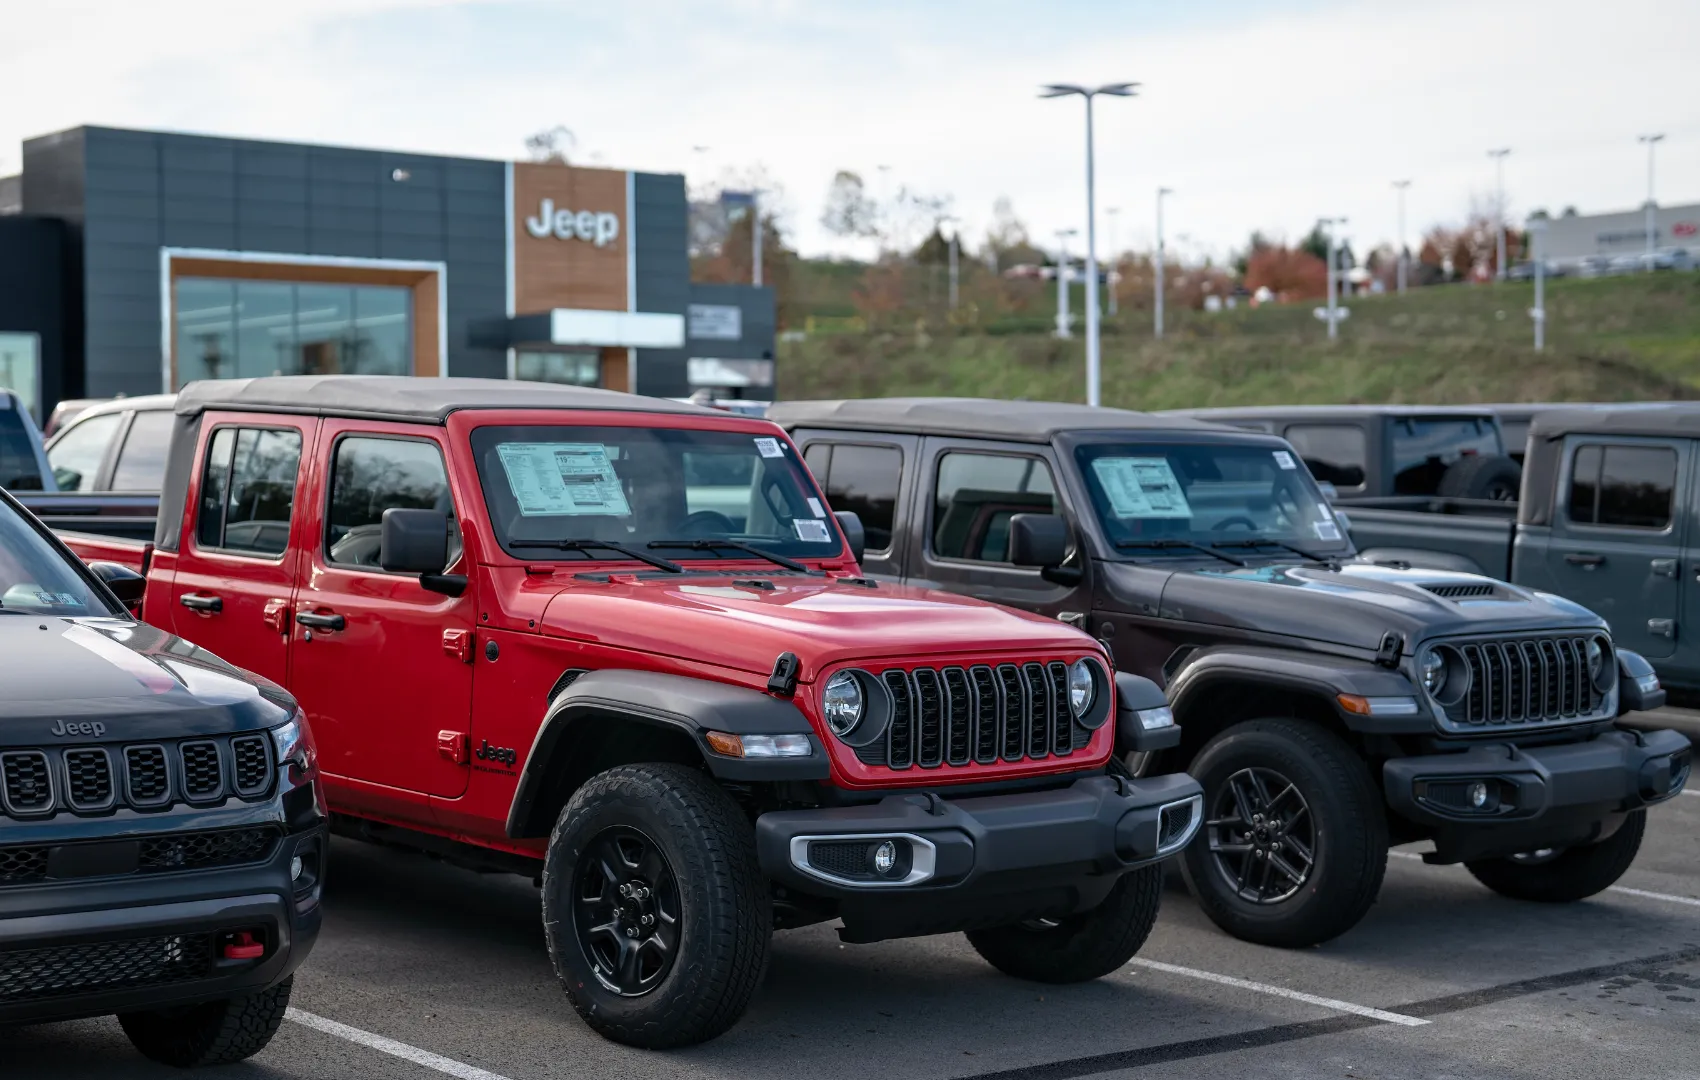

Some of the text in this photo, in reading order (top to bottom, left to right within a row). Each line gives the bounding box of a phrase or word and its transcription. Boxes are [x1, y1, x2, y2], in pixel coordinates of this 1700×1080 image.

[525, 198, 618, 247] Jeep
[51, 719, 106, 737] Jeep
[476, 739, 516, 768] Jeep
